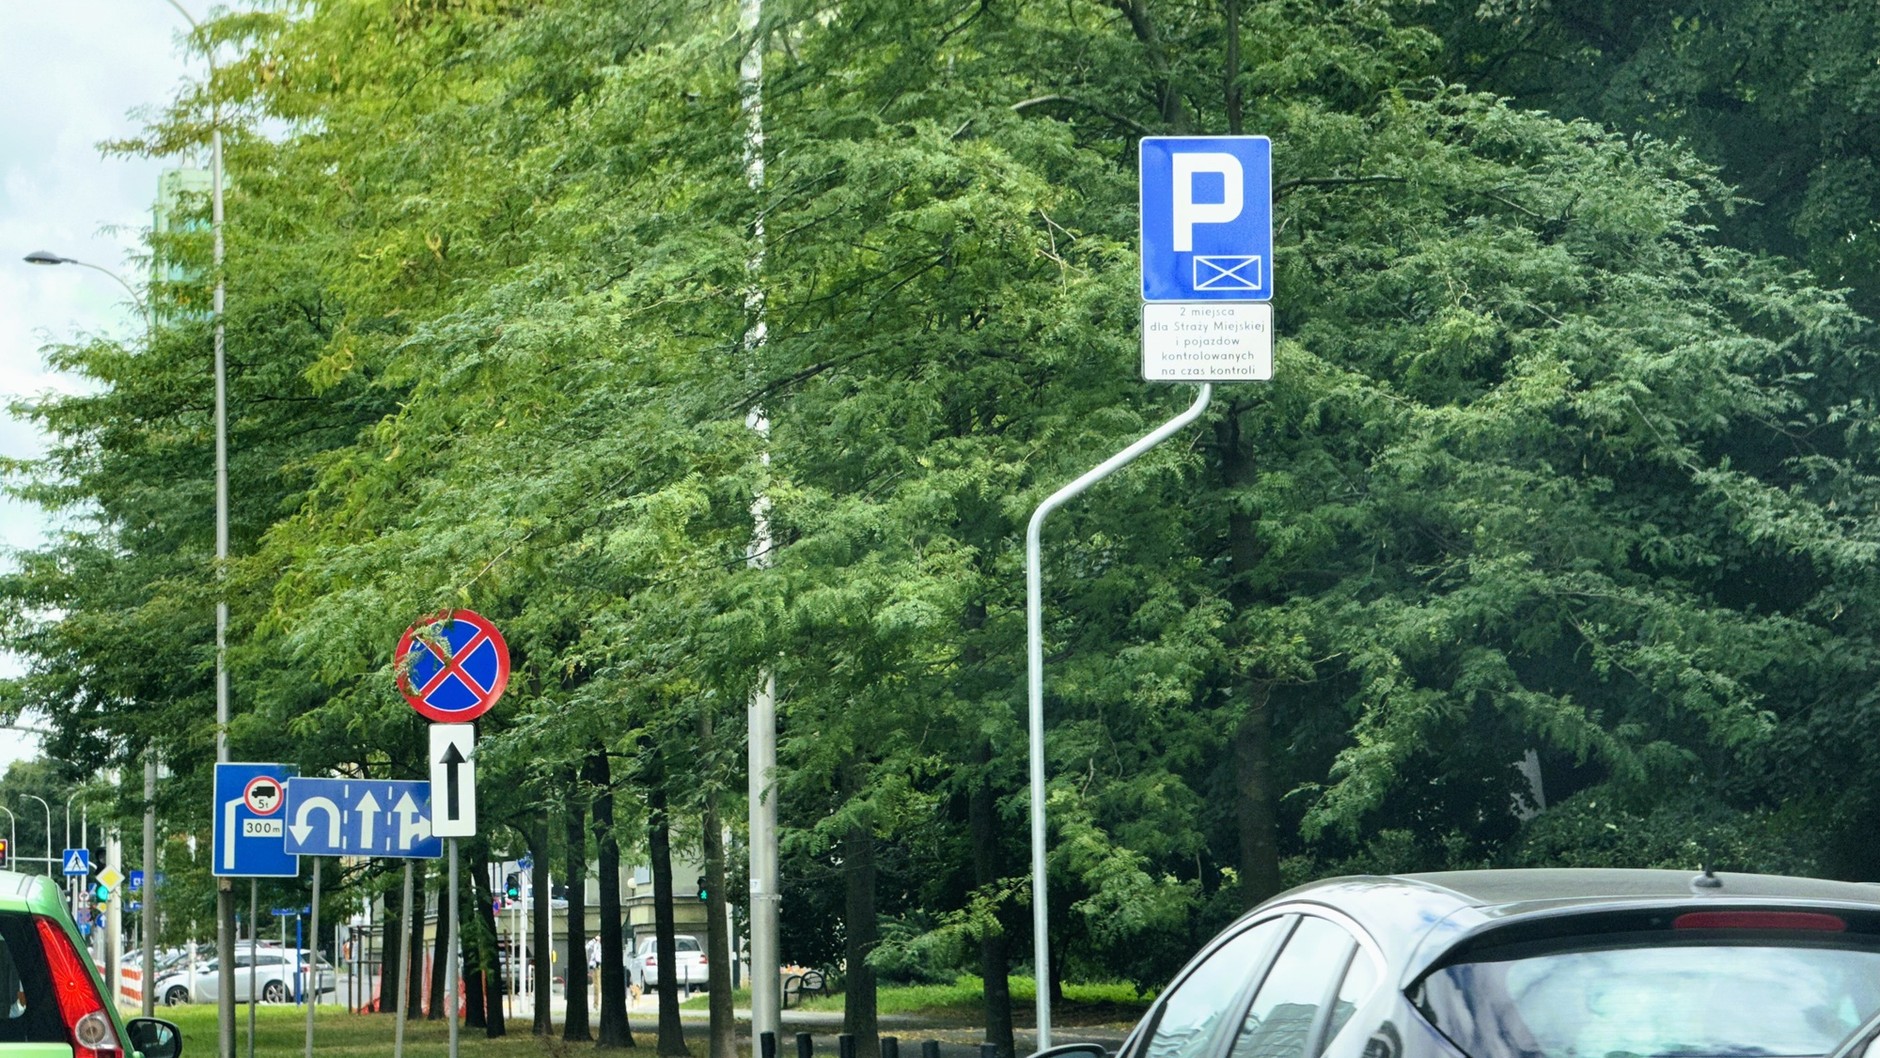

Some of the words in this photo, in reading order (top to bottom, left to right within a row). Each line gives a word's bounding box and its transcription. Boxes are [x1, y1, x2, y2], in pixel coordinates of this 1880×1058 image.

[1173, 153, 1243, 251] P
[1180, 307, 1186, 316] 2
[1191, 307, 1235, 318] miejsca
[1150, 322, 1168, 331] dla
[1213, 321, 1265, 332] Miejskiej
[1161, 351, 1255, 362] kontrolowanych
[1181, 368, 1205, 376] czas
[1210, 365, 1256, 375] kontroli
